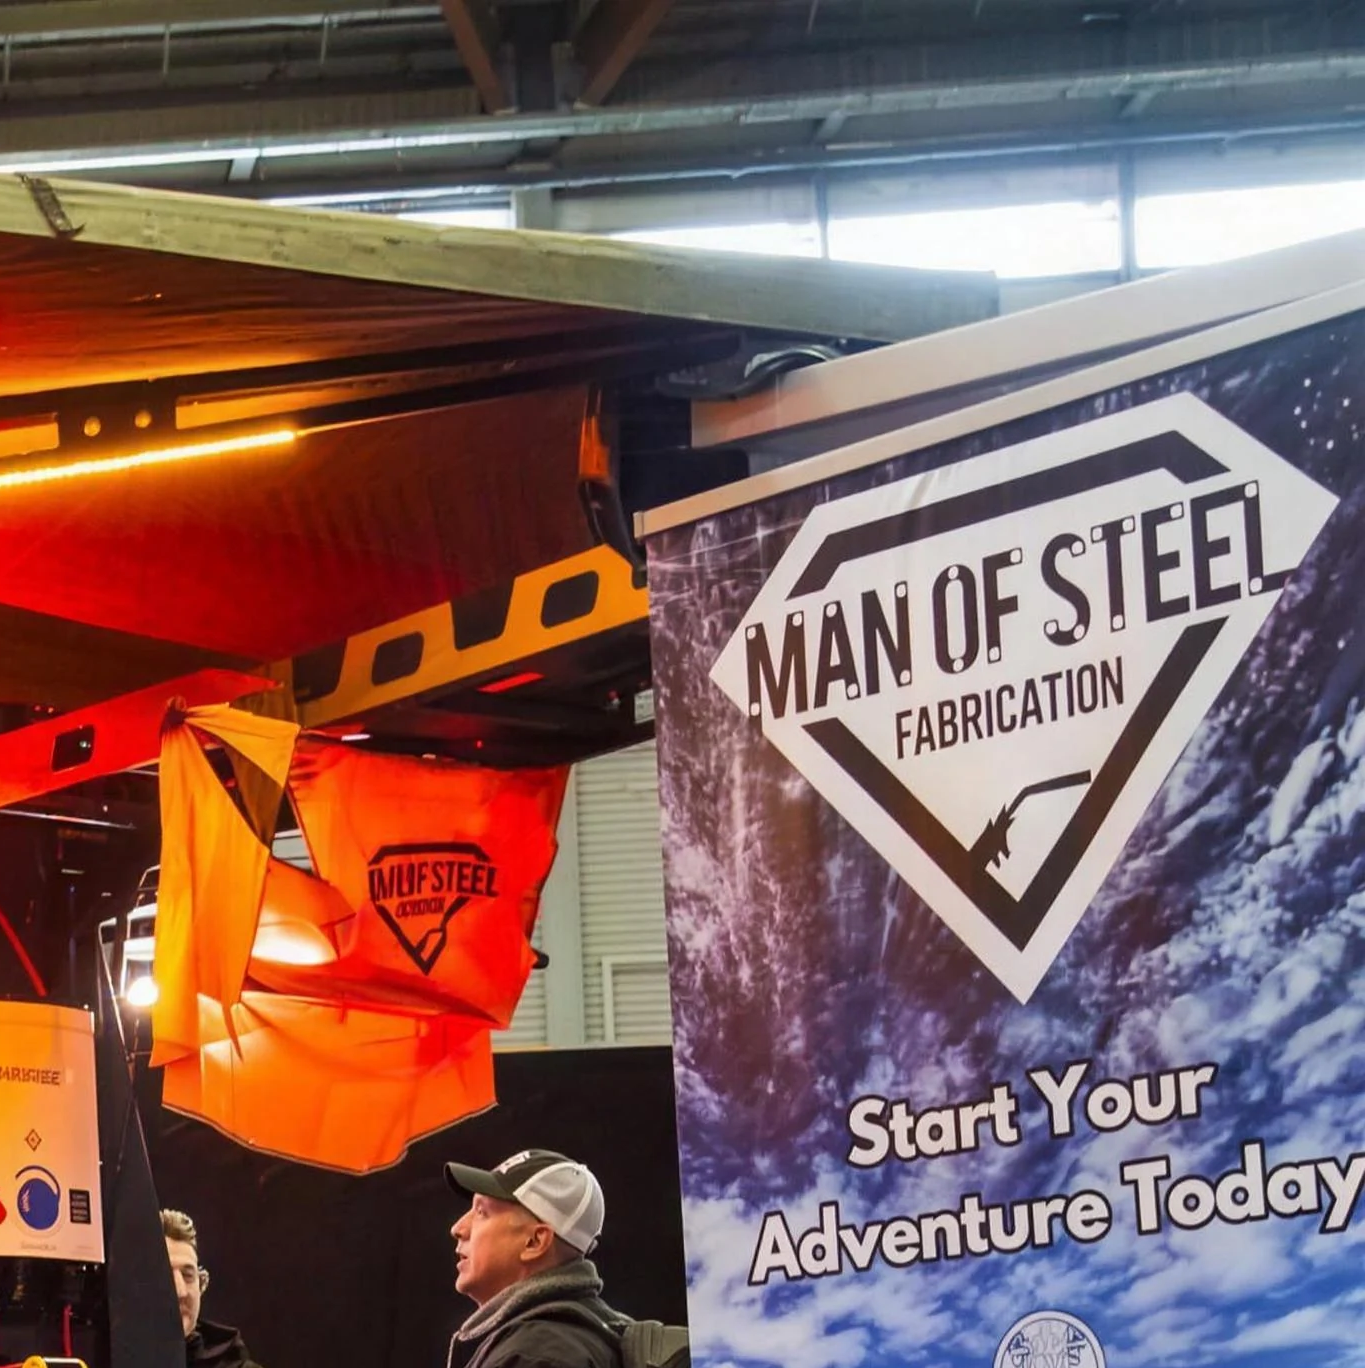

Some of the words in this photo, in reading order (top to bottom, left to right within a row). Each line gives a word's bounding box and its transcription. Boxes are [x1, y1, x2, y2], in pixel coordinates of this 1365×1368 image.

[746, 581, 913, 720] MAN
[932, 547, 1024, 675] OF
[1040, 480, 1295, 647] STEEL
[895, 656, 1125, 760] FABRICATION
[430, 860, 500, 898] STEEL
[847, 1087, 1019, 1168] Start
[1030, 1058, 1218, 1139] Your
[749, 1189, 1112, 1286] Adventure
[1121, 1140, 1365, 1235] Today
